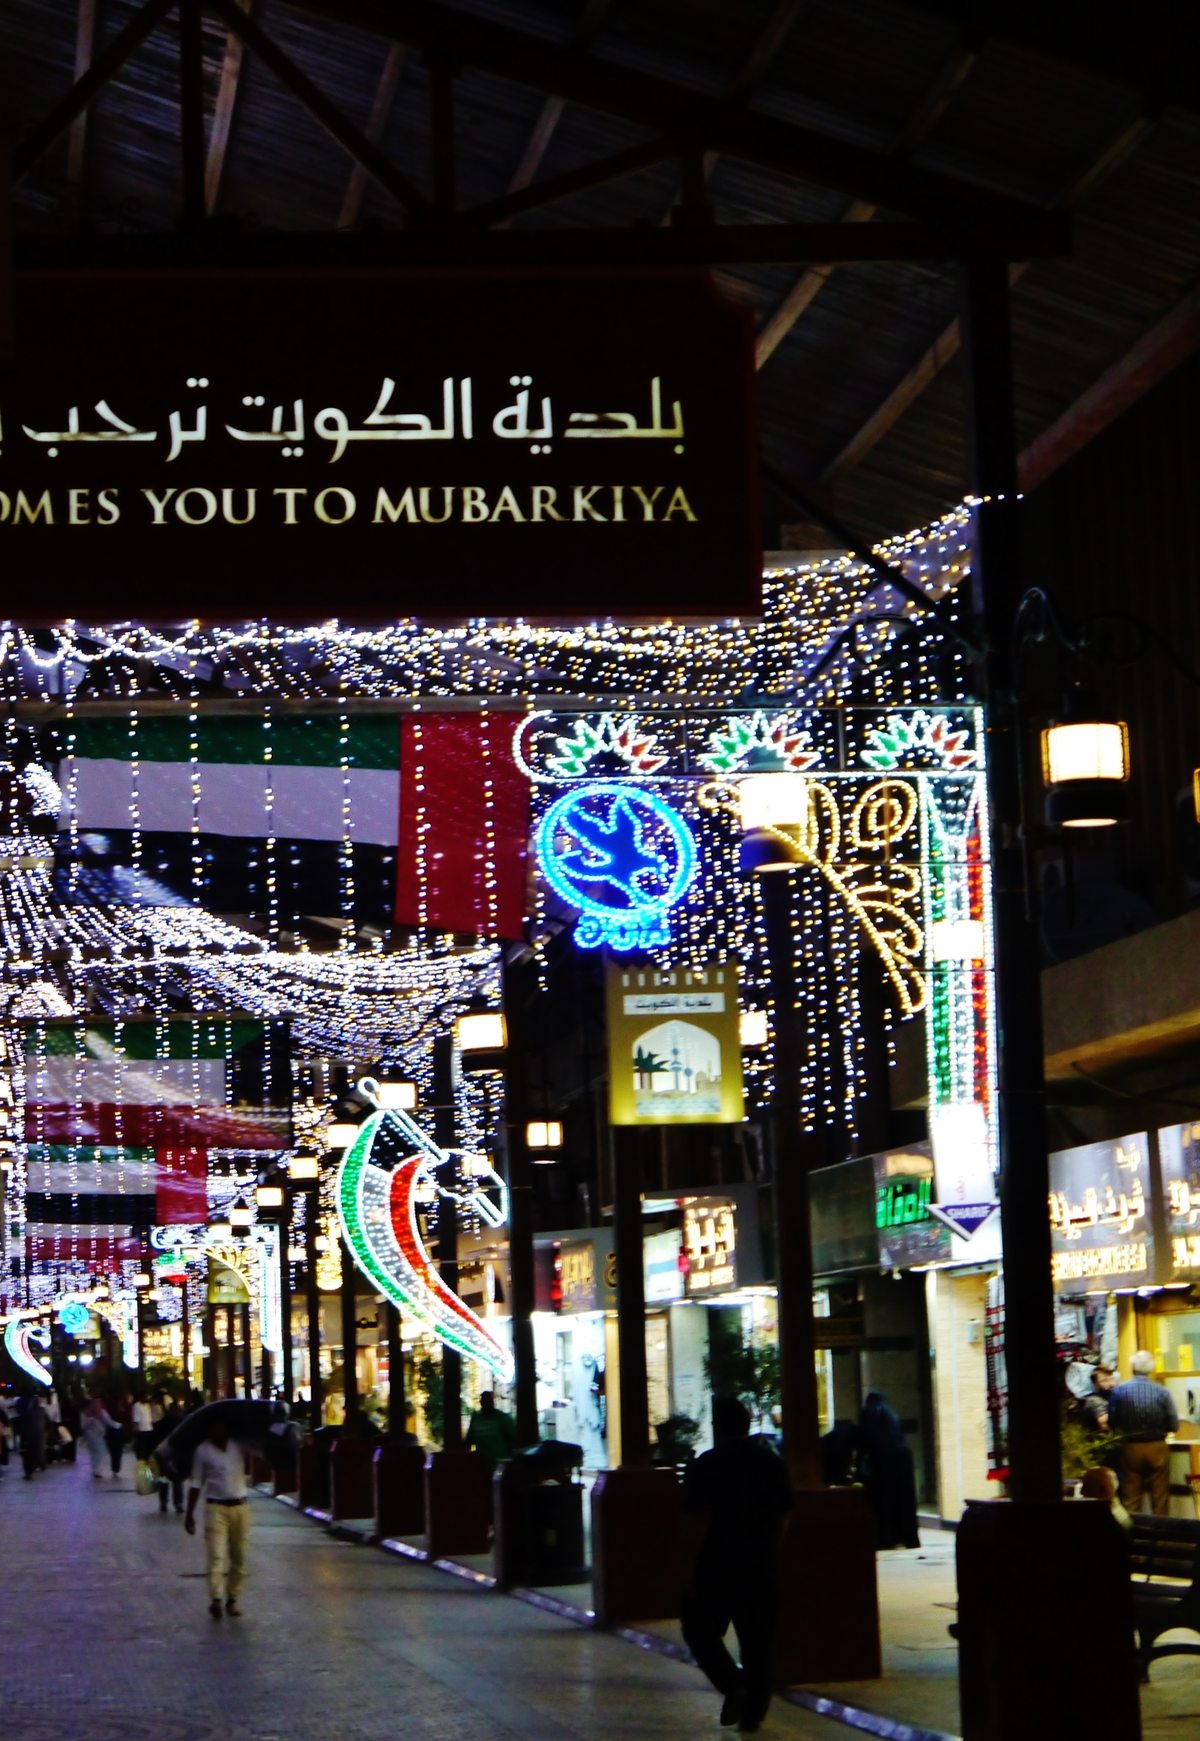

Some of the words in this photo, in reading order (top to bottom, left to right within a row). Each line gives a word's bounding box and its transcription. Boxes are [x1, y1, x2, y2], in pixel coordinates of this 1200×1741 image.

[20, 376, 211, 464] ترحب
[223, 375, 475, 465] الكويت
[491, 374, 686, 456] بلدية
[140, 487, 258, 526] YOU
[273, 485, 358, 526] TO
[371, 485, 699, 525] MUBARKIYA
